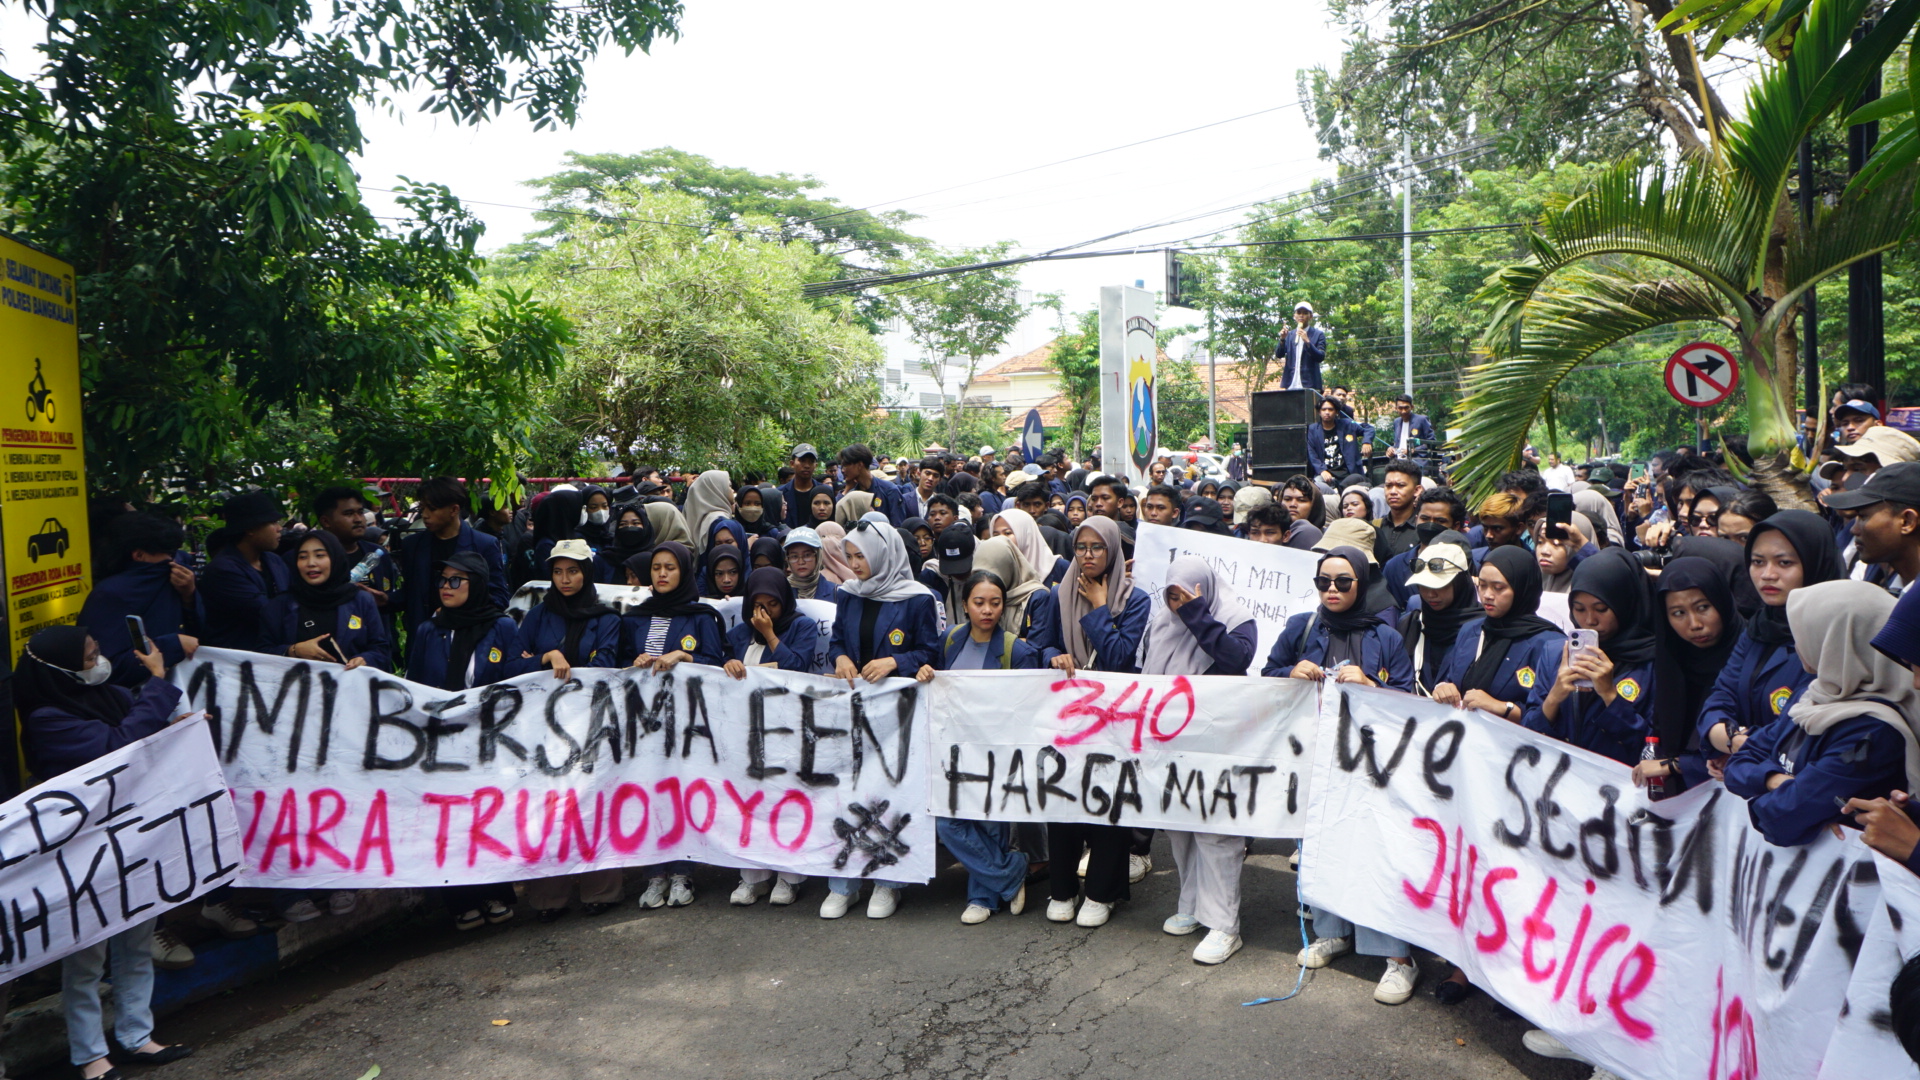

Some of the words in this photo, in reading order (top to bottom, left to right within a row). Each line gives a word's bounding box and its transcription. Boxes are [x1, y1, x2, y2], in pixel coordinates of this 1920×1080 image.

[2, 286, 31, 313] POLRES
[1247, 565, 1291, 594] MATI
[363, 672, 720, 777] BERSAMA
[745, 685, 918, 791] EEN
[1050, 675, 1196, 753] 340
[423, 776, 814, 868] TRUNOJOYO
[942, 744, 1143, 825] HARGA
[56, 789, 239, 944] KEJI
